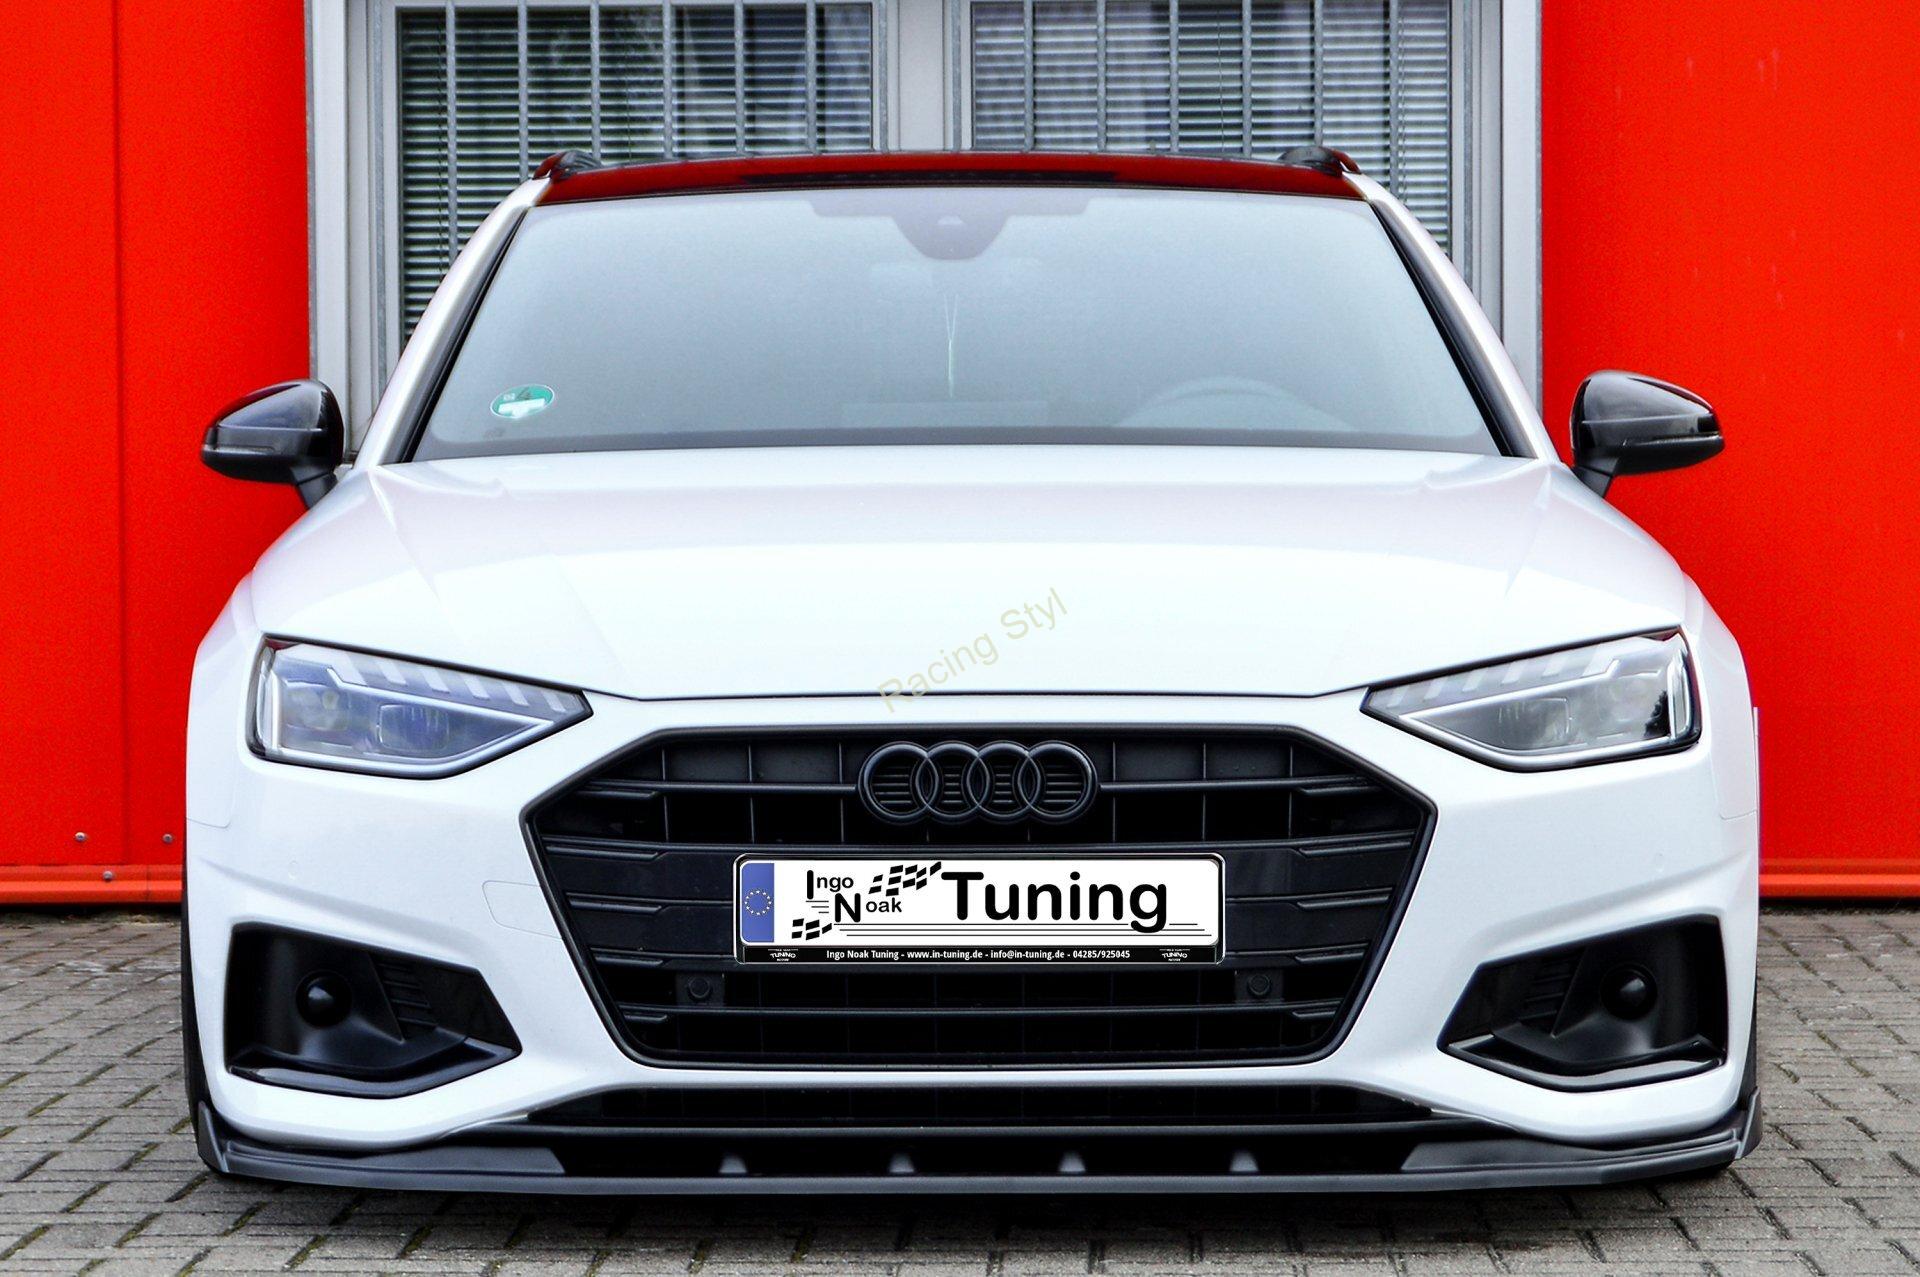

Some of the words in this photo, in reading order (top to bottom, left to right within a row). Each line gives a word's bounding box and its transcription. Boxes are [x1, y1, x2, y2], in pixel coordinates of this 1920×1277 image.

[806, 869, 854, 900] Ingo
[834, 892, 903, 923] Noak
[940, 871, 1167, 934] Tuning
[826, 950, 845, 961] Ingo
[847, 950, 869, 959] Noak
[871, 950, 900, 961] Tuning
[907, 950, 983, 961] www.in-tuning.de
[990, 950, 1065, 961] info@in-tuning.de
[1072, 950, 1131, 959] 04285/925045
